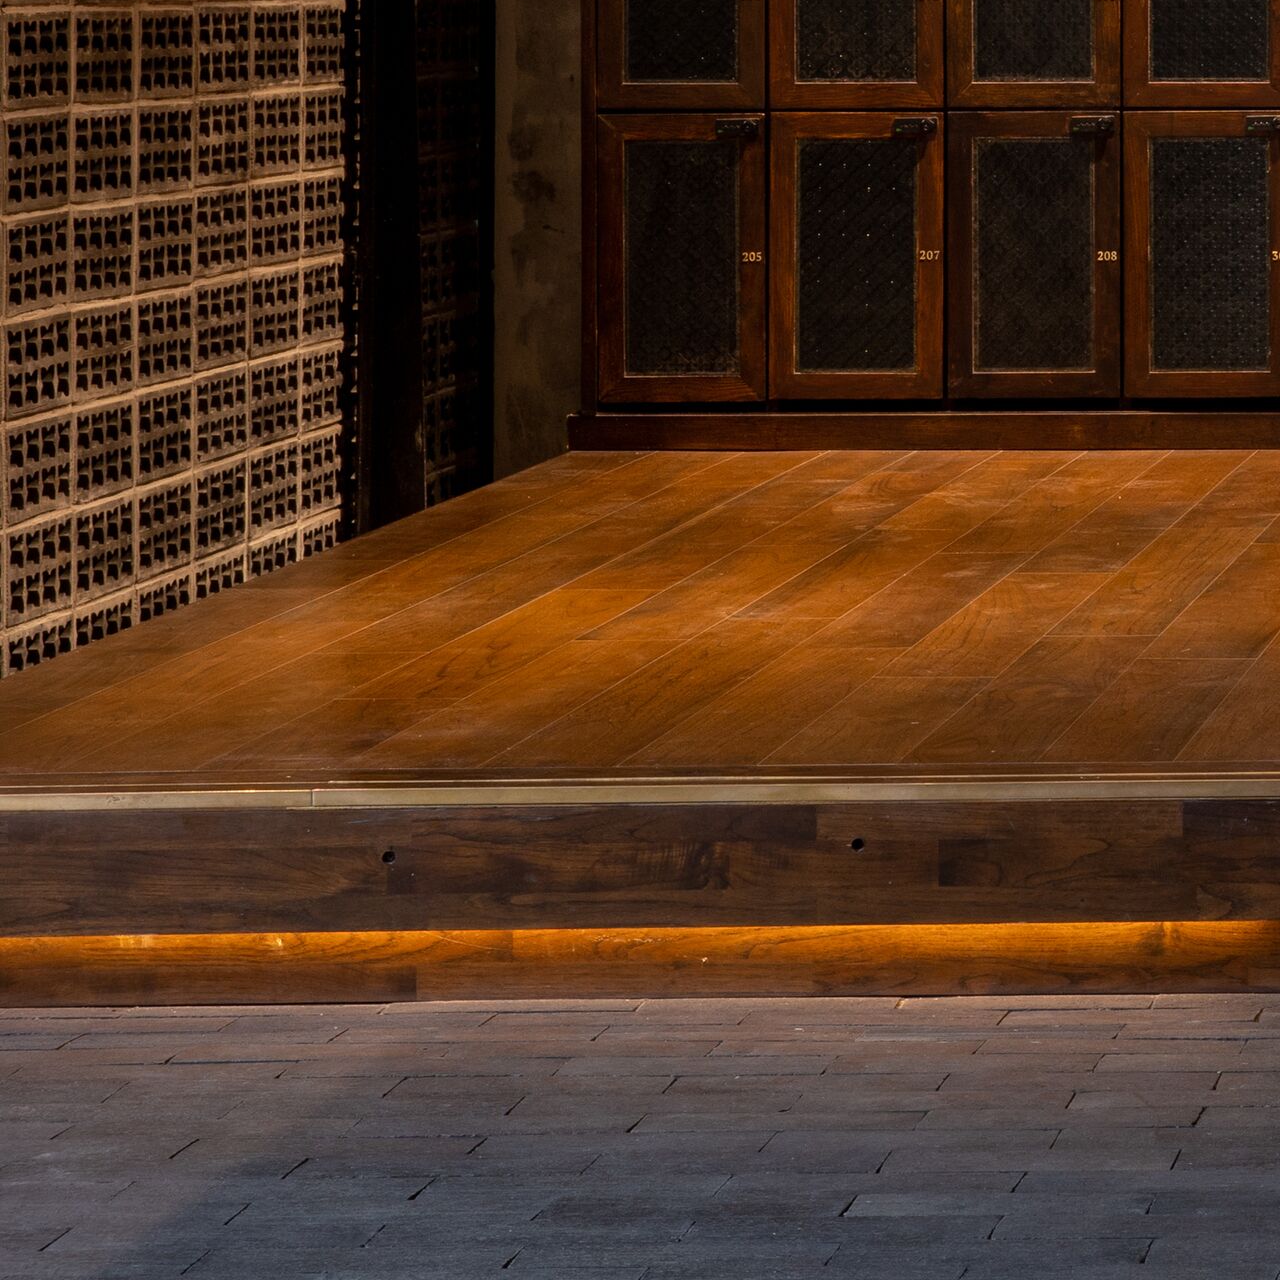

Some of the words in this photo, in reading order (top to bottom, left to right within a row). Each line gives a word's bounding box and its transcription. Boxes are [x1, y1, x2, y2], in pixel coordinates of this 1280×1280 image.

[742, 251, 762, 262] 205
[919, 249, 940, 261] 207
[1097, 250, 1118, 261] 208
